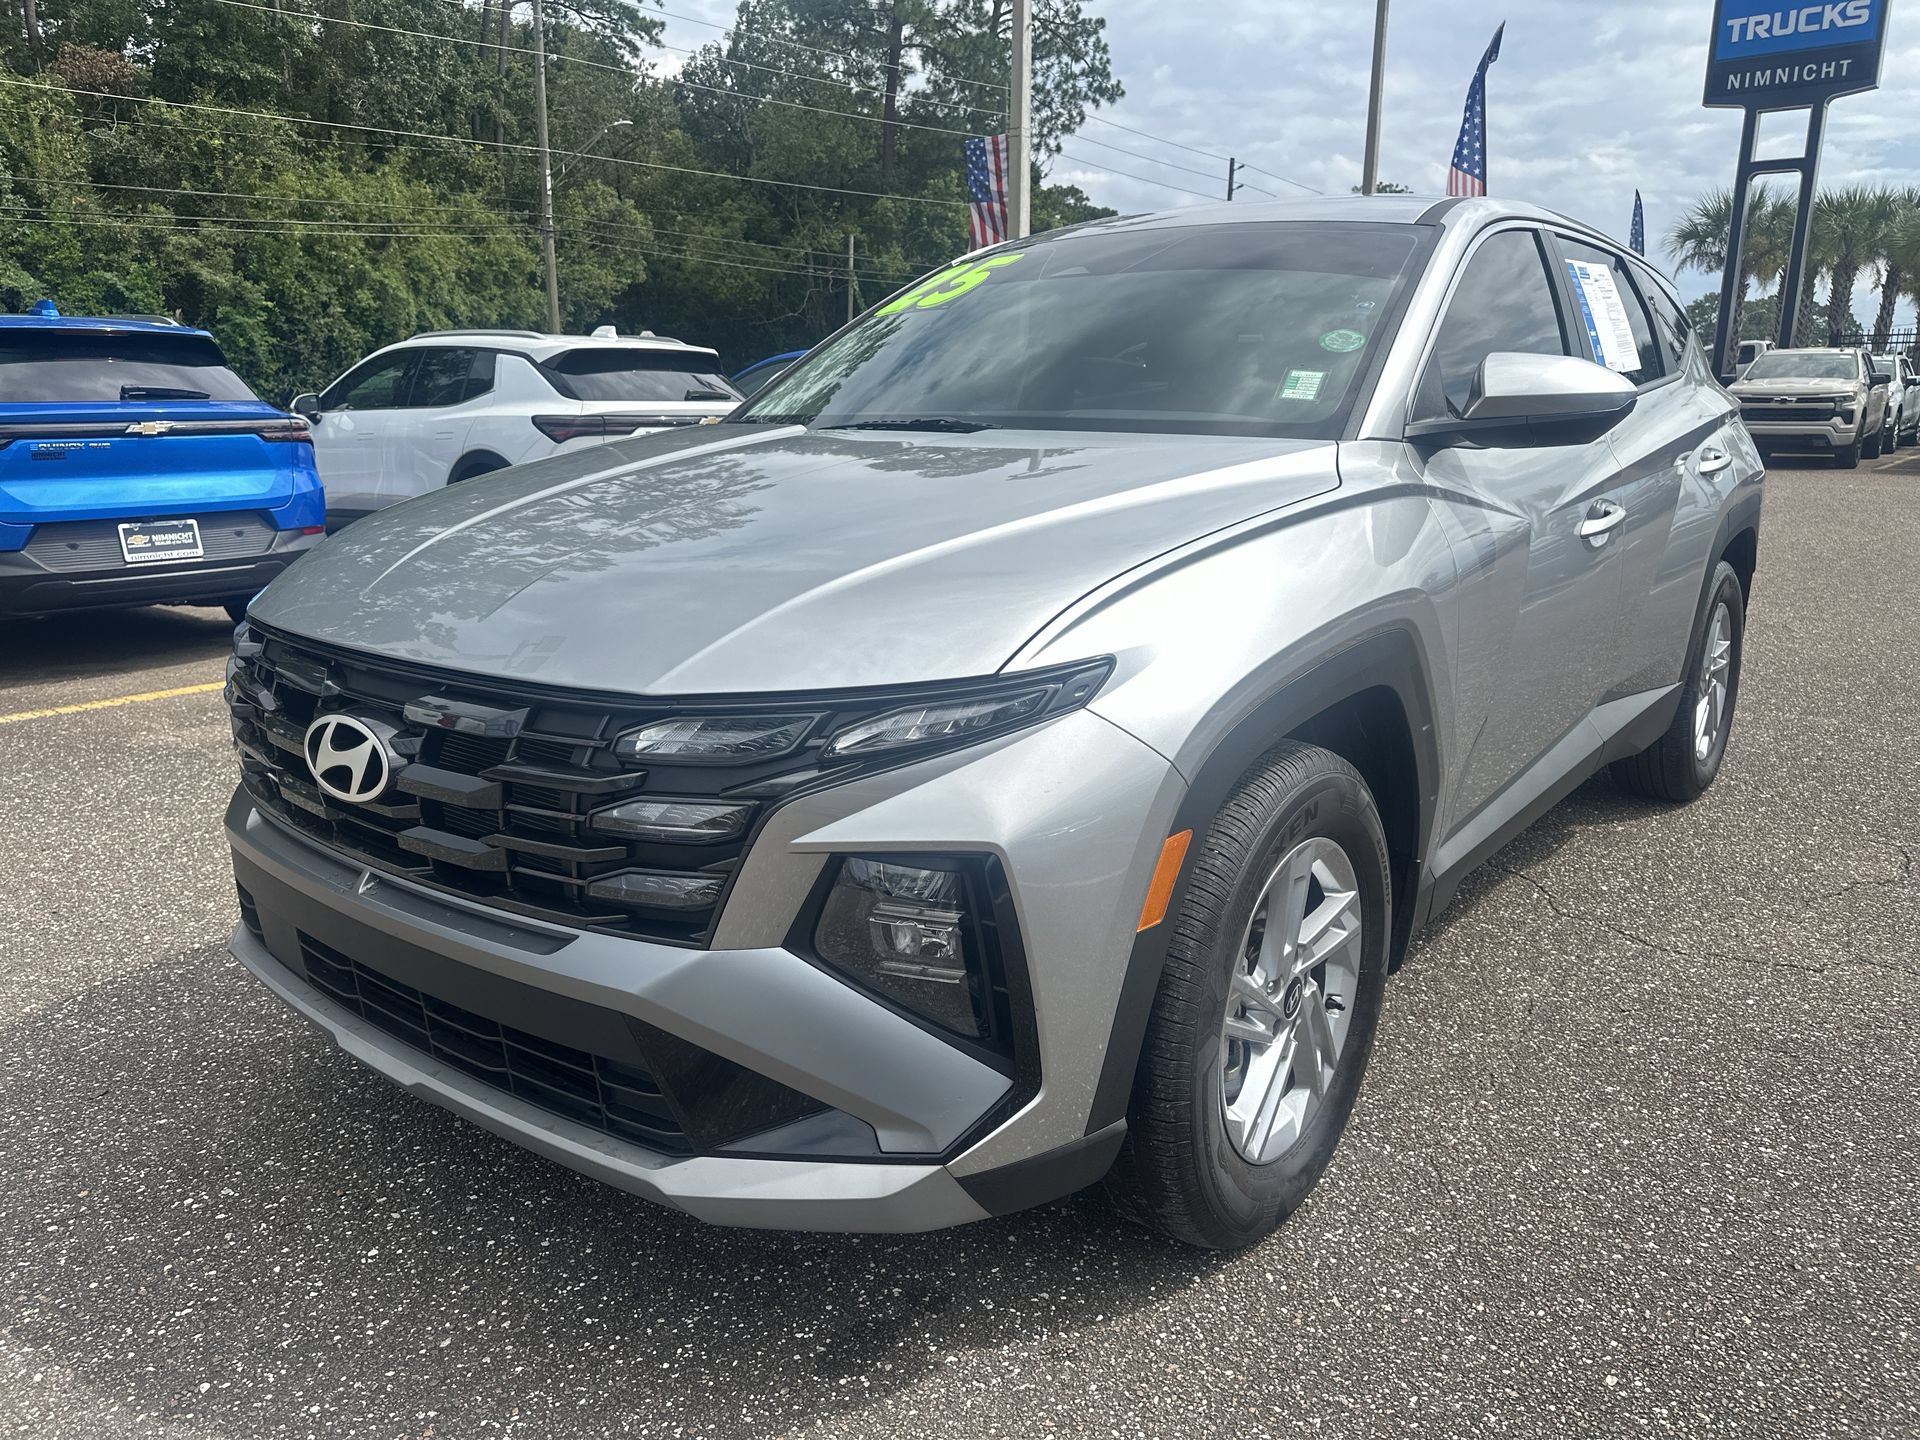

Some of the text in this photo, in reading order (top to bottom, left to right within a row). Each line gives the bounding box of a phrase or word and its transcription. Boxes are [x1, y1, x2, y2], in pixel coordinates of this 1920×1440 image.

[1727, 0, 1870, 42] TRUCKS
[1728, 59, 1852, 90] NIMNICHT
[873, 252, 1025, 317] 25
[151, 531, 194, 542] NIMNICHT
